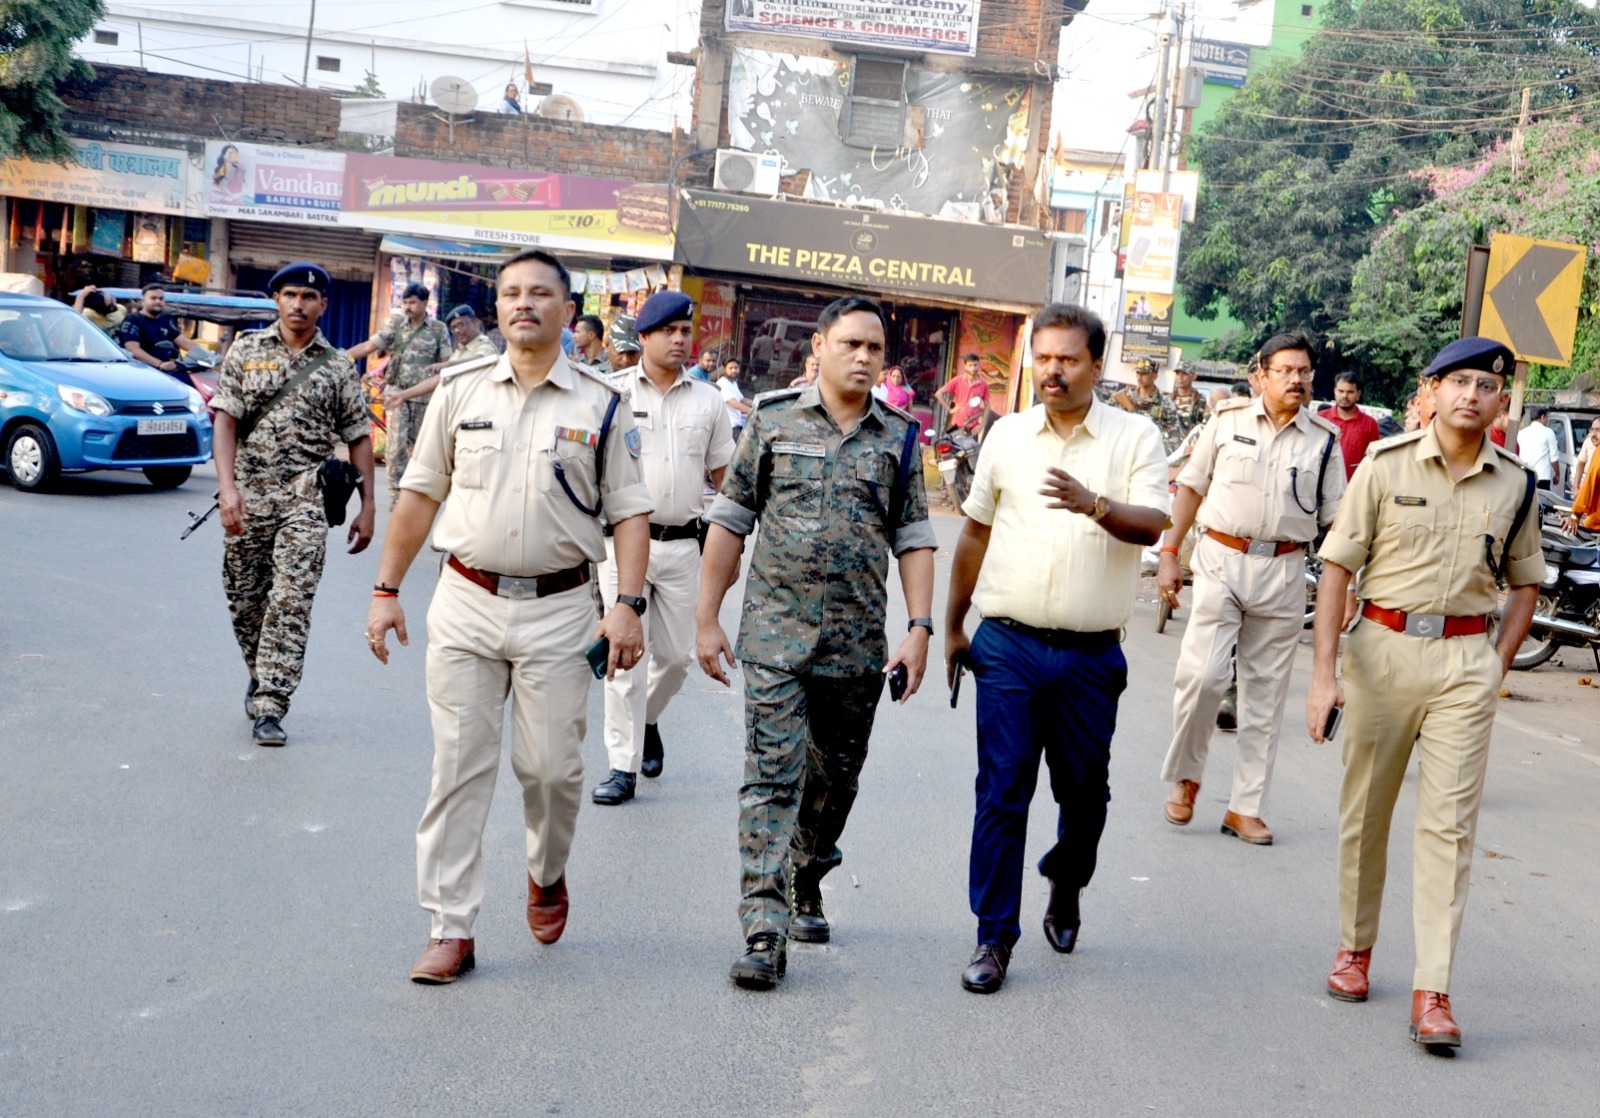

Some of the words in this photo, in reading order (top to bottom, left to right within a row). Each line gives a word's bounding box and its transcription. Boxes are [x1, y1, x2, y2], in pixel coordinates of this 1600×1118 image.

[763, 3, 777, 11] On
[794, 6, 834, 17] Concept
[837, 10, 853, 18] For
[856, 11, 882, 21] Class
[861, 0, 968, 14] ademy
[759, 11, 838, 29] SCIENCE
[842, 20, 856, 30] &
[860, 21, 968, 42] COMMERCE
[1193, 42, 1225, 61] HOTEL
[926, 107, 953, 120] THAT
[107, 151, 181, 178] वस्त्रालय
[282, 151, 305, 160] Choice
[368, 175, 477, 207] munch
[266, 195, 305, 206] SAREES
[474, 229, 508, 241] RITESH
[510, 233, 541, 243] STORE
[746, 242, 791, 267] THE
[795, 248, 863, 275] PIZZA
[868, 258, 976, 287] CENTRAL
